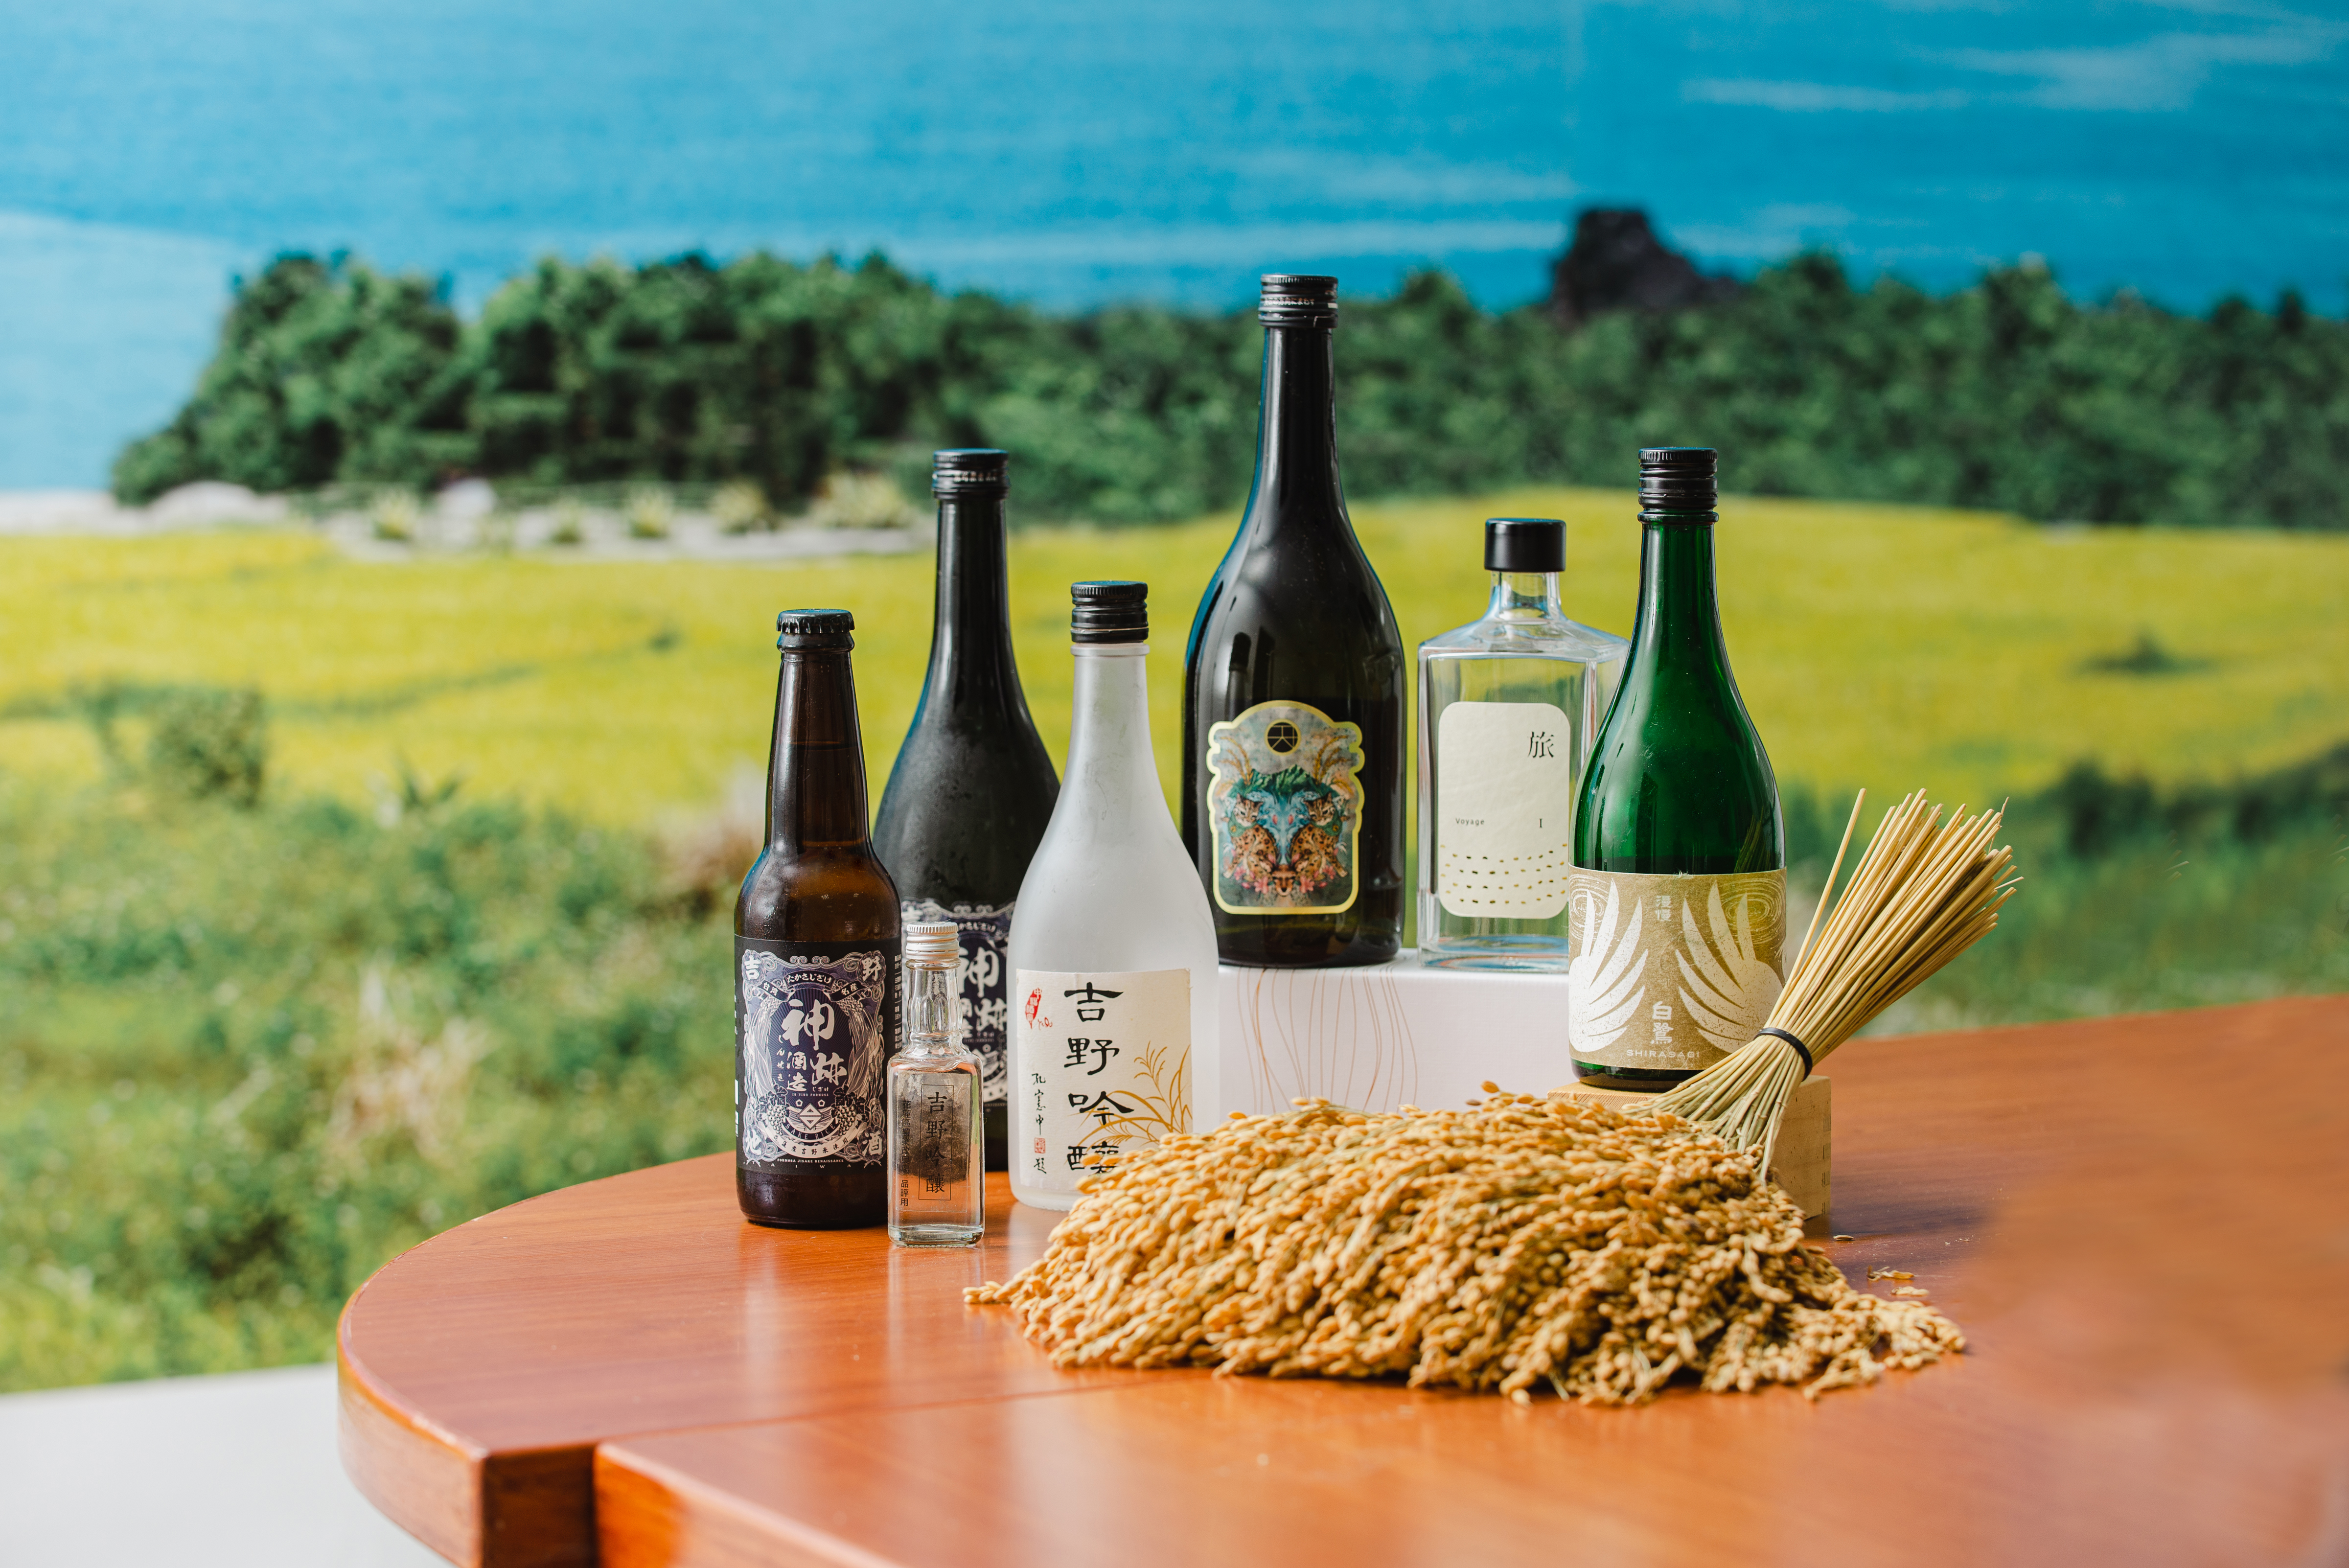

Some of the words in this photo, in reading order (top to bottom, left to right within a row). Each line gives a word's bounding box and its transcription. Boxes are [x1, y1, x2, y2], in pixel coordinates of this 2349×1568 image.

[1527, 731, 1555, 759] 旅
[1455, 818, 1485, 827] Voyage
[1655, 895, 1673, 922] 漫慢
[1651, 1001, 1674, 1044] 白鷺
[1627, 1050, 1700, 1058] SHIRASAGI
[785, 1123, 808, 1140] SAKE
[815, 1124, 836, 1139] RICE
[900, 1180, 909, 1206] 品評用
